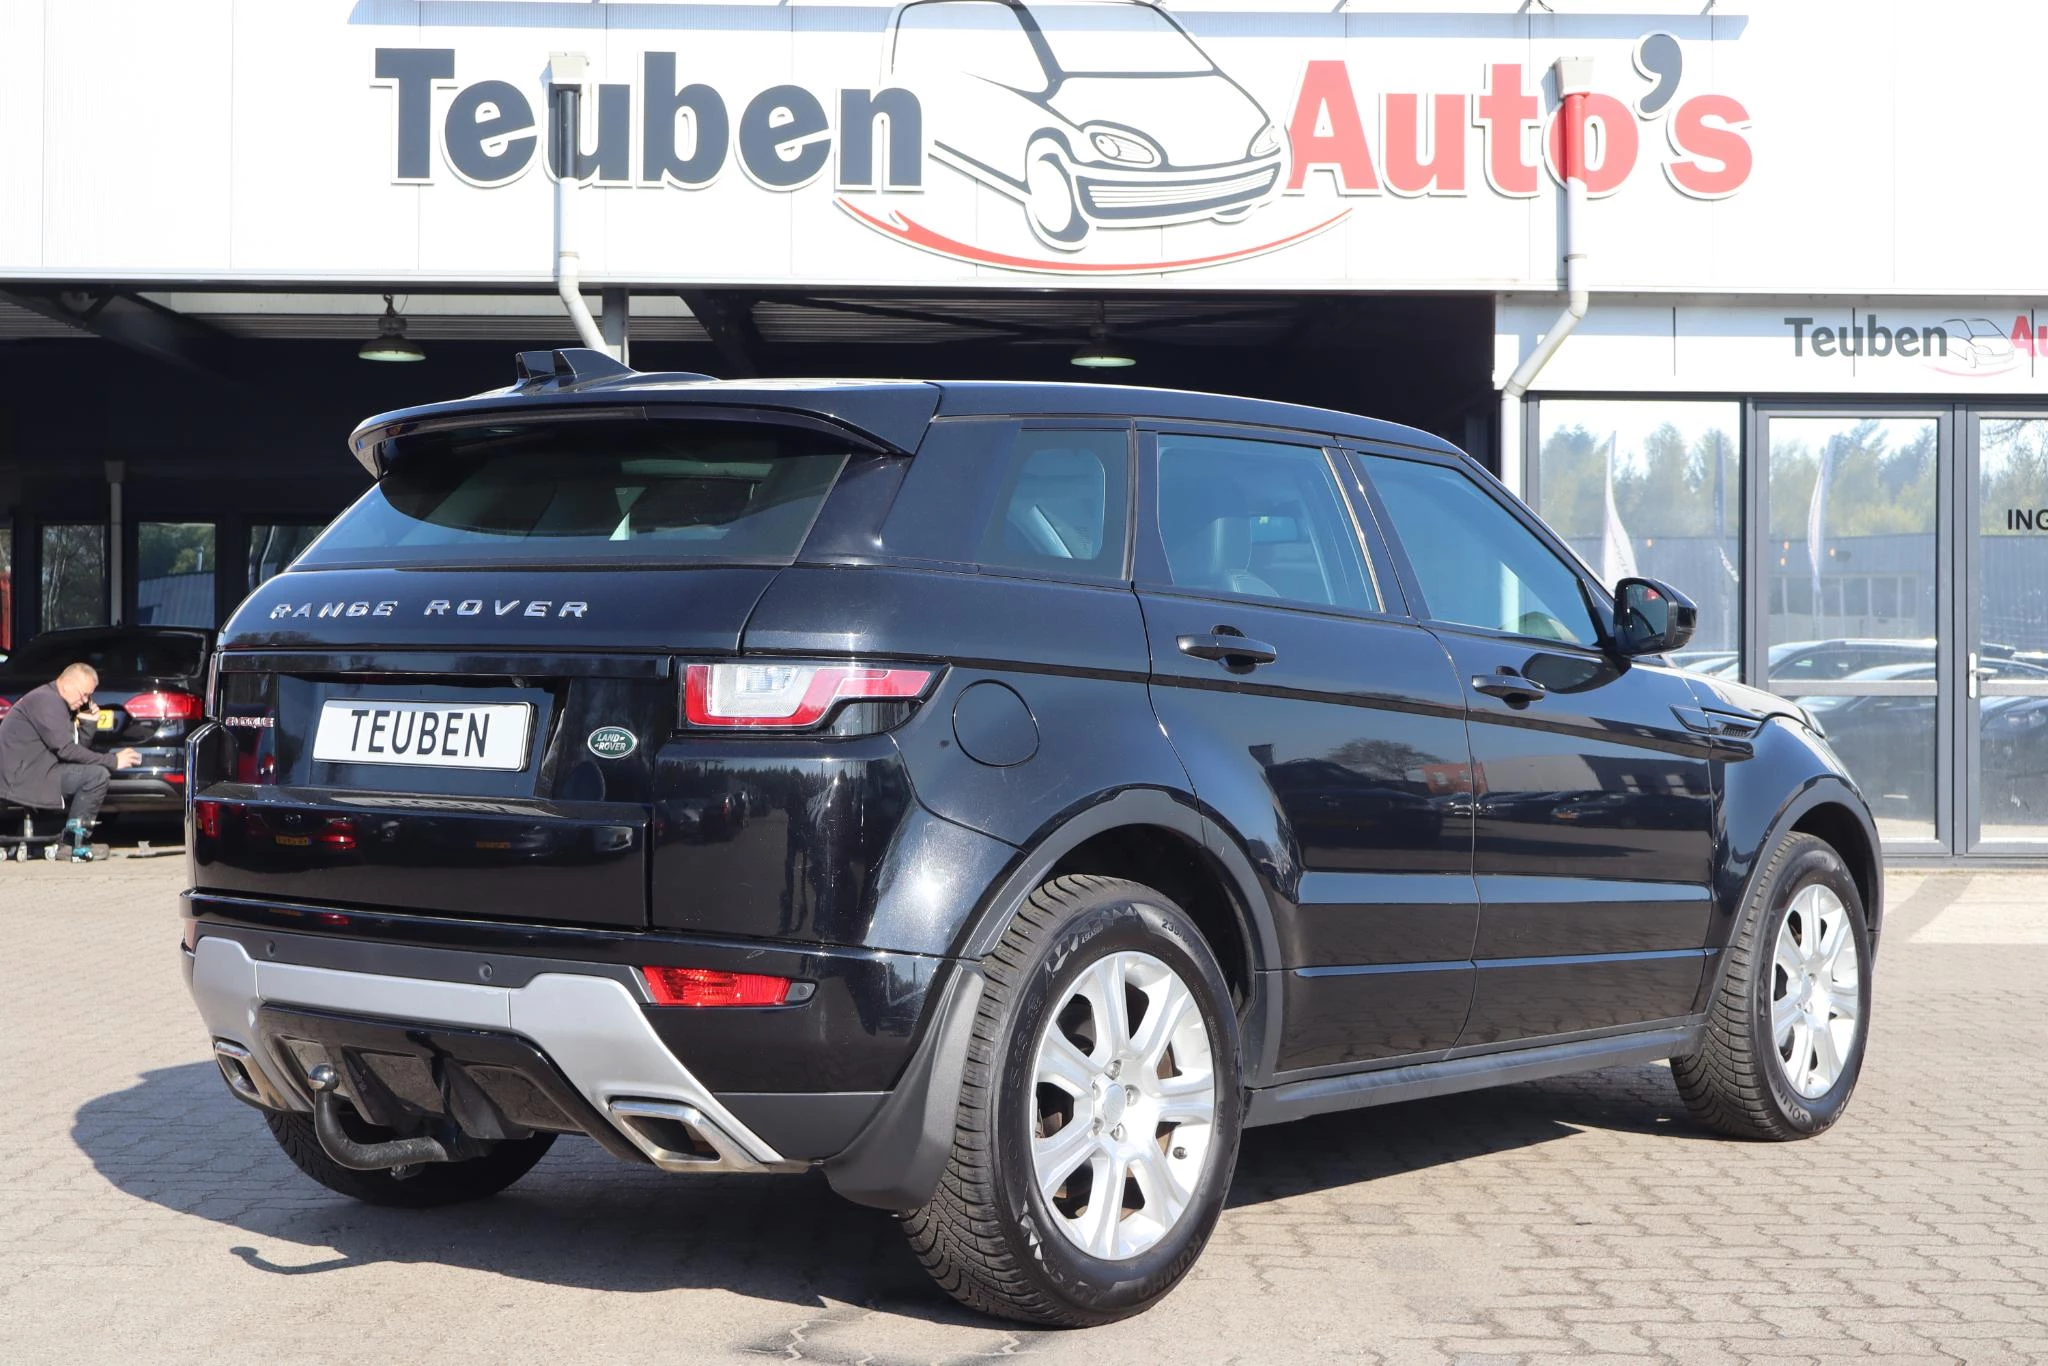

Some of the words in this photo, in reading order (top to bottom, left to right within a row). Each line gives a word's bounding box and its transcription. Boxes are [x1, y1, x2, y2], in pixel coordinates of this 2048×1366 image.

[374, 47, 922, 189] Teuben
[1286, 33, 1753, 194] Auto's
[1783, 314, 1948, 357] Teuben
[270, 600, 399, 620] RANGE
[423, 599, 588, 618] ROVER
[351, 709, 490, 758] TEUBEN
